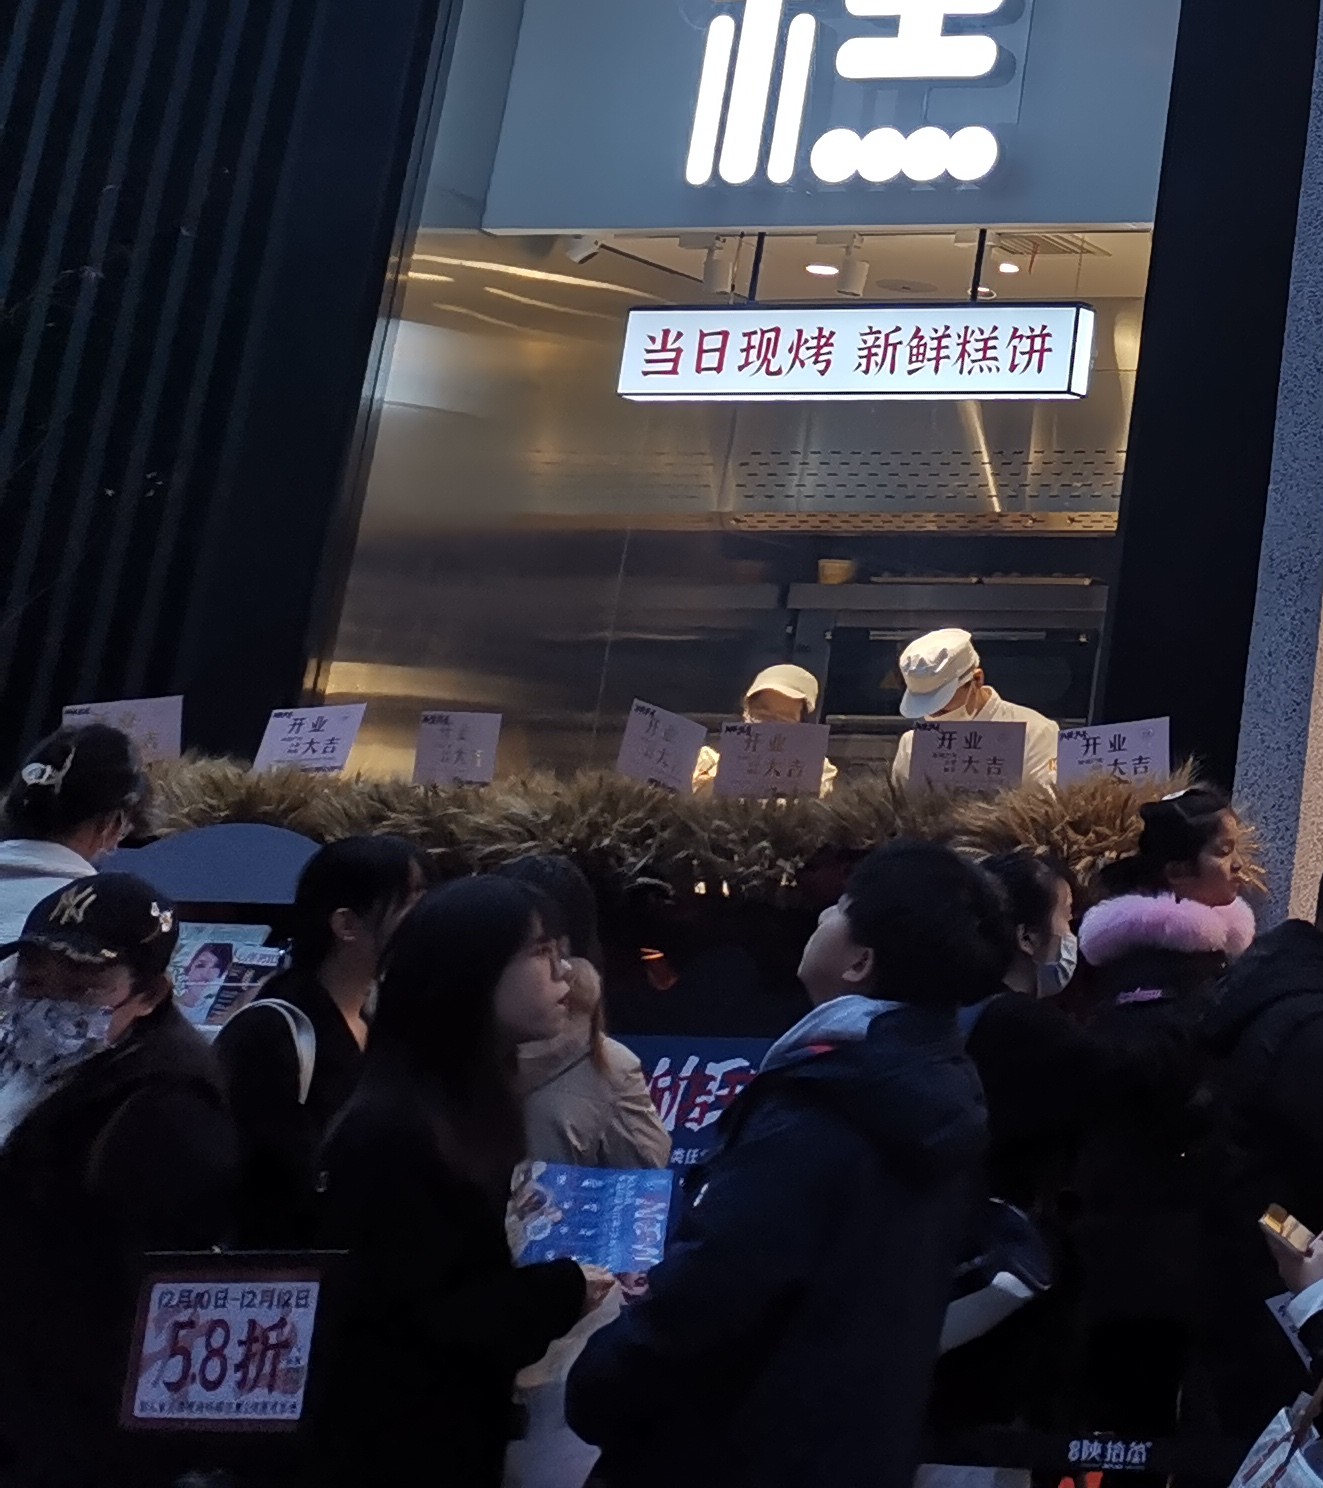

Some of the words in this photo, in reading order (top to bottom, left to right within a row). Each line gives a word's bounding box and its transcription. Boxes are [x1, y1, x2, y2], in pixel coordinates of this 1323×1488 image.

[640, 326, 838, 379] 当日现烤
[852, 324, 1055, 376] 新鲜糕饼
[287, 715, 329, 734] 开业
[301, 735, 342, 755] 大吉
[936, 730, 984, 750] 开业
[1080, 734, 1128, 756] 开业
[961, 755, 1005, 777] 大吉
[1106, 754, 1152, 777] 大吉
